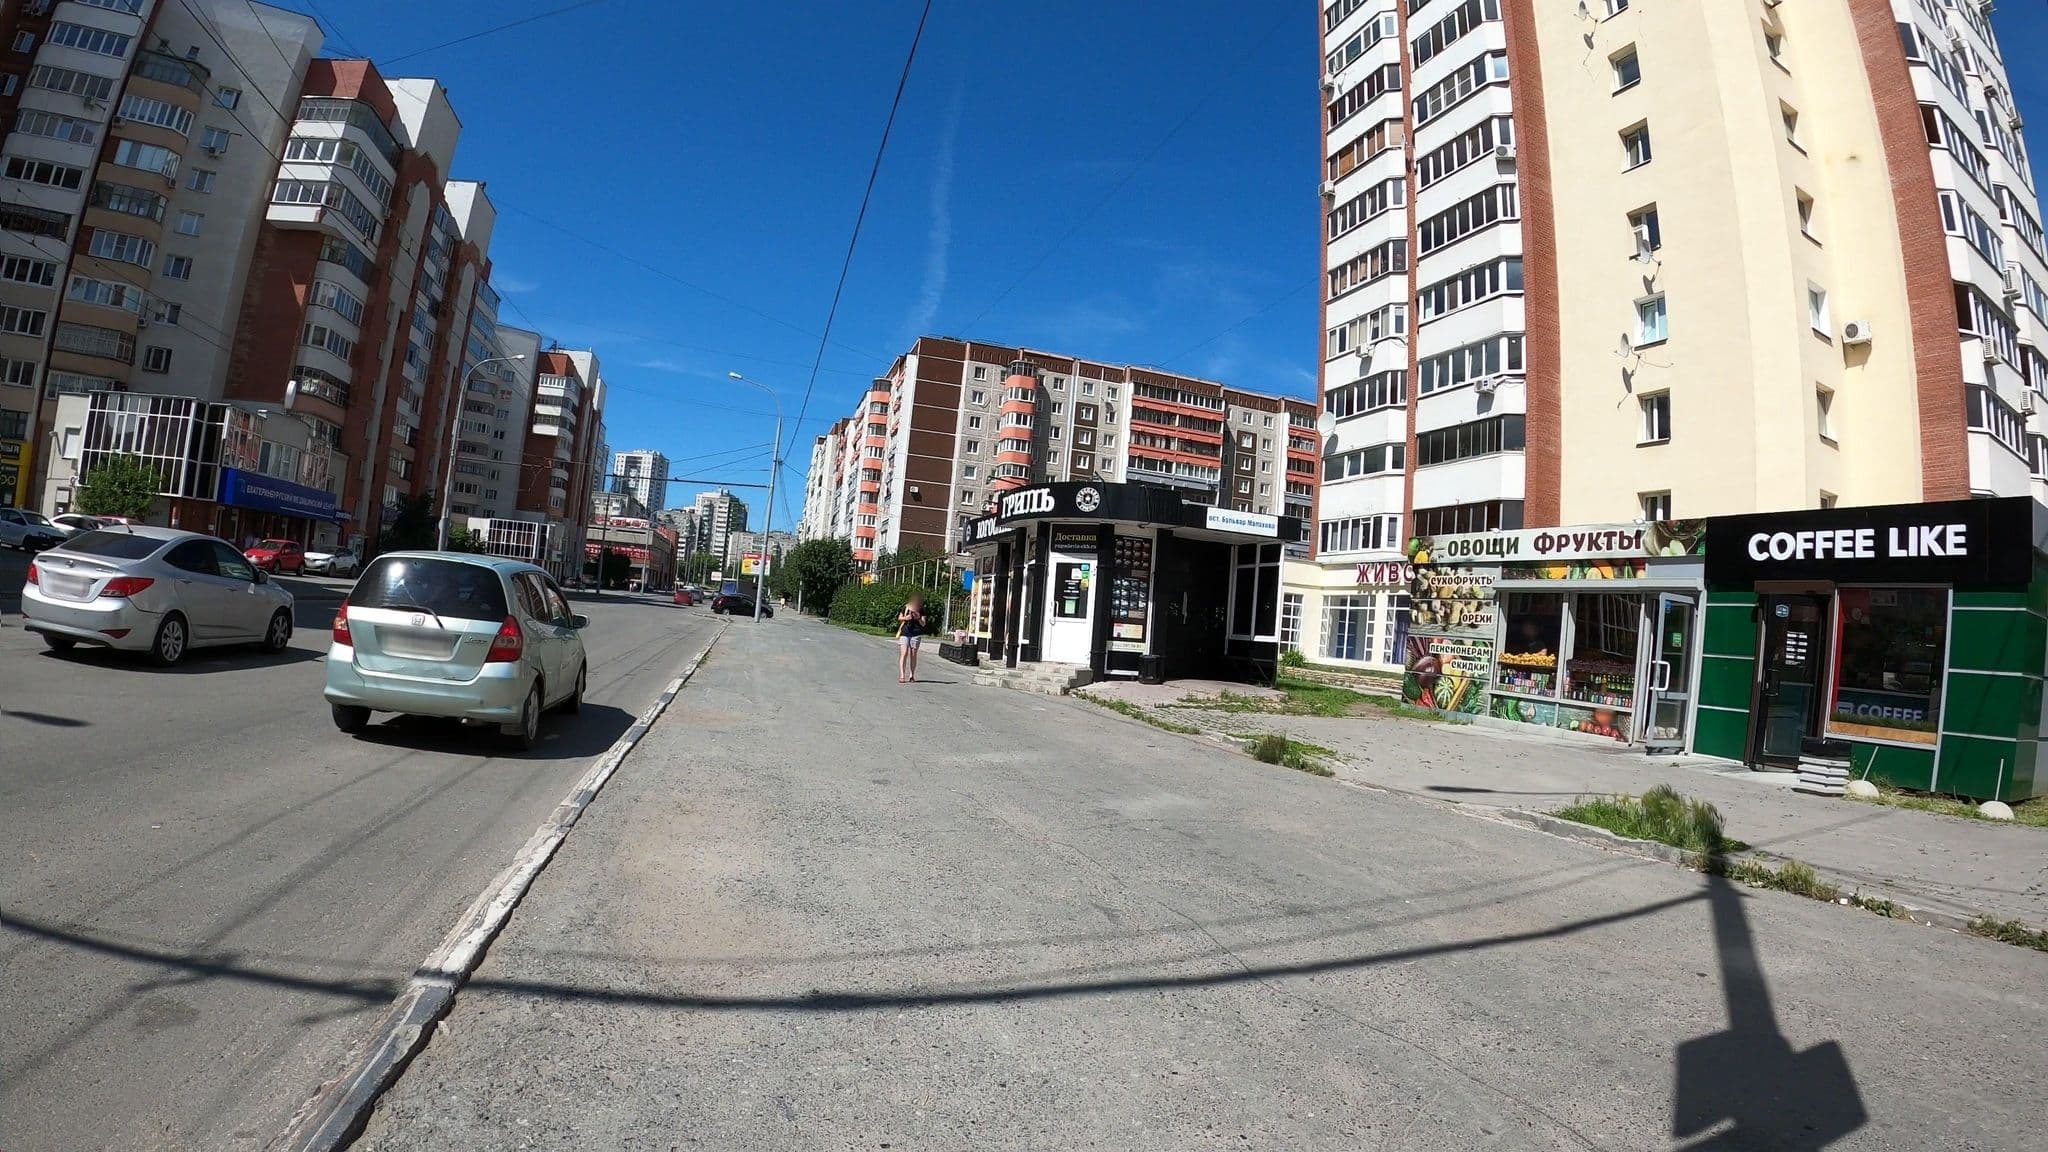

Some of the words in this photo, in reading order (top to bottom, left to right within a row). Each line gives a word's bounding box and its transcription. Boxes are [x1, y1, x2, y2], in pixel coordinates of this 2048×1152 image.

[1000, 487, 1055, 519] ГРИЛЬ
[1055, 532, 1097, 542] Доставка
[1748, 528, 1875, 561] COFFEE
[1888, 524, 1967, 557] LIKE
[1447, 536, 1520, 559] ОВОЩИ
[1533, 529, 1642, 555] ФРУКТЫ
[1430, 576, 1496, 585] СУХОФРУКТЫ
[1462, 613, 1492, 624] ОРЕХИ
[1430, 644, 1490, 657] ПЕНСИОНЕРАМ
[1452, 660, 1488, 673] СКИДКИ!
[1857, 703, 1922, 720] COFFEE
